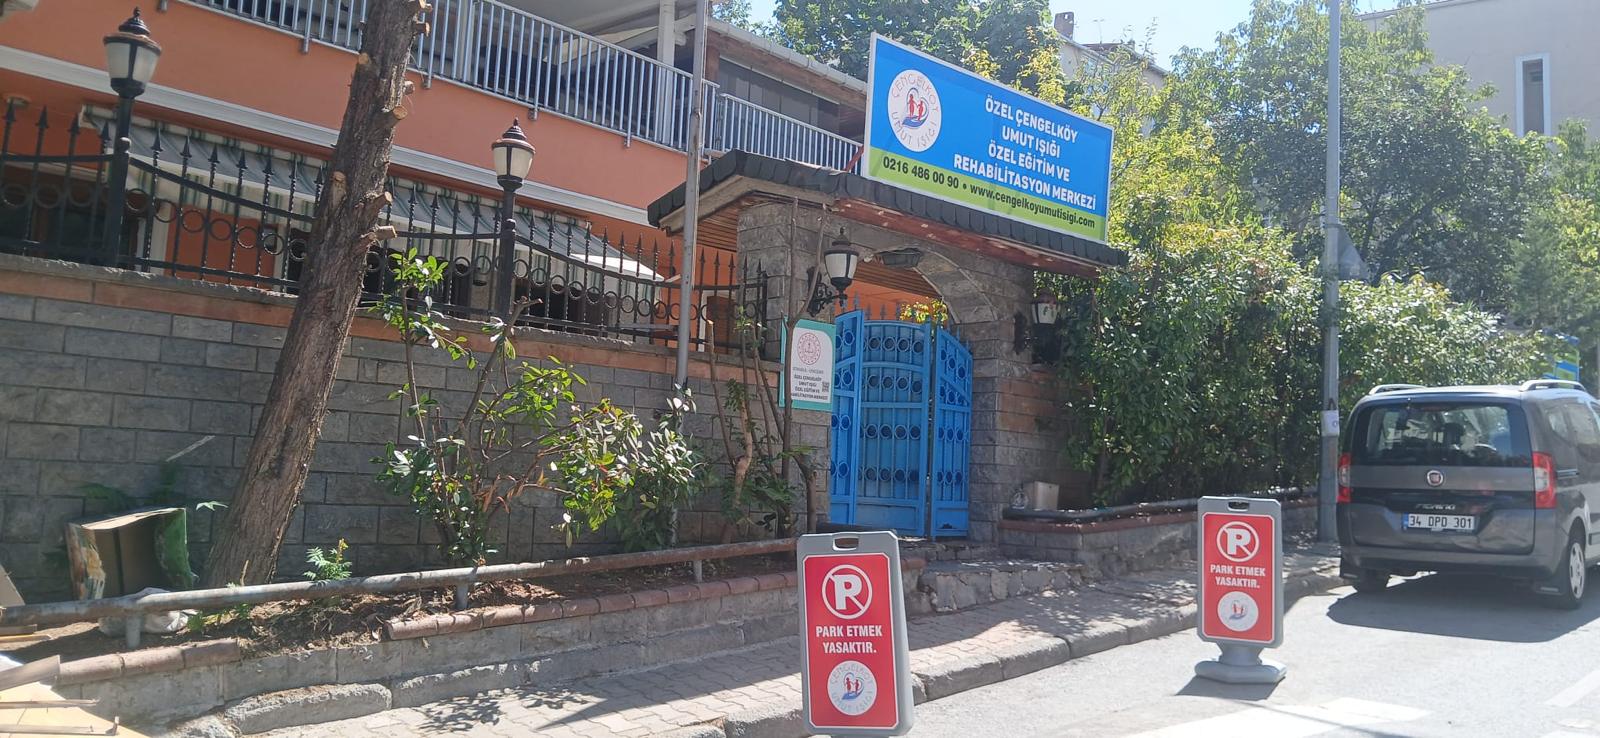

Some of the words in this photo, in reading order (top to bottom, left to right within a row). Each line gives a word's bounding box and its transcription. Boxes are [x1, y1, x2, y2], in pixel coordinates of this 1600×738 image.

[985, 94, 1014, 120] ÖZEL
[1015, 109, 1078, 143] ÇENGELKÖY
[1002, 125, 1035, 149] UMUT
[1035, 137, 1060, 158] IŞIĞI
[988, 139, 1017, 165] ÖZEL
[1018, 152, 1055, 177] EĞİTİM
[1056, 165, 1070, 182] VE
[883, 156, 908, 174] 0216
[911, 165, 930, 180] 486
[932, 171, 945, 185] 00
[947, 175, 959, 189] 90
[970, 184, 1095, 228] www.cengelkoyumutisigi.com
[953, 153, 1051, 197] REHABİLİTASYON
[1052, 185, 1096, 210] MERKEZİ
[1410, 515, 1421, 526] 34
[1428, 516, 1448, 527] DPD
[1454, 517, 1472, 528] 301
[1210, 564, 1233, 574] PARK
[1235, 566, 1266, 577] ETMEK
[1215, 576, 1260, 588] YASAKTIR.
[815, 625, 844, 637] PARK
[846, 625, 883, 637] ETMEK
[822, 641, 877, 654] YASAKTIR.
